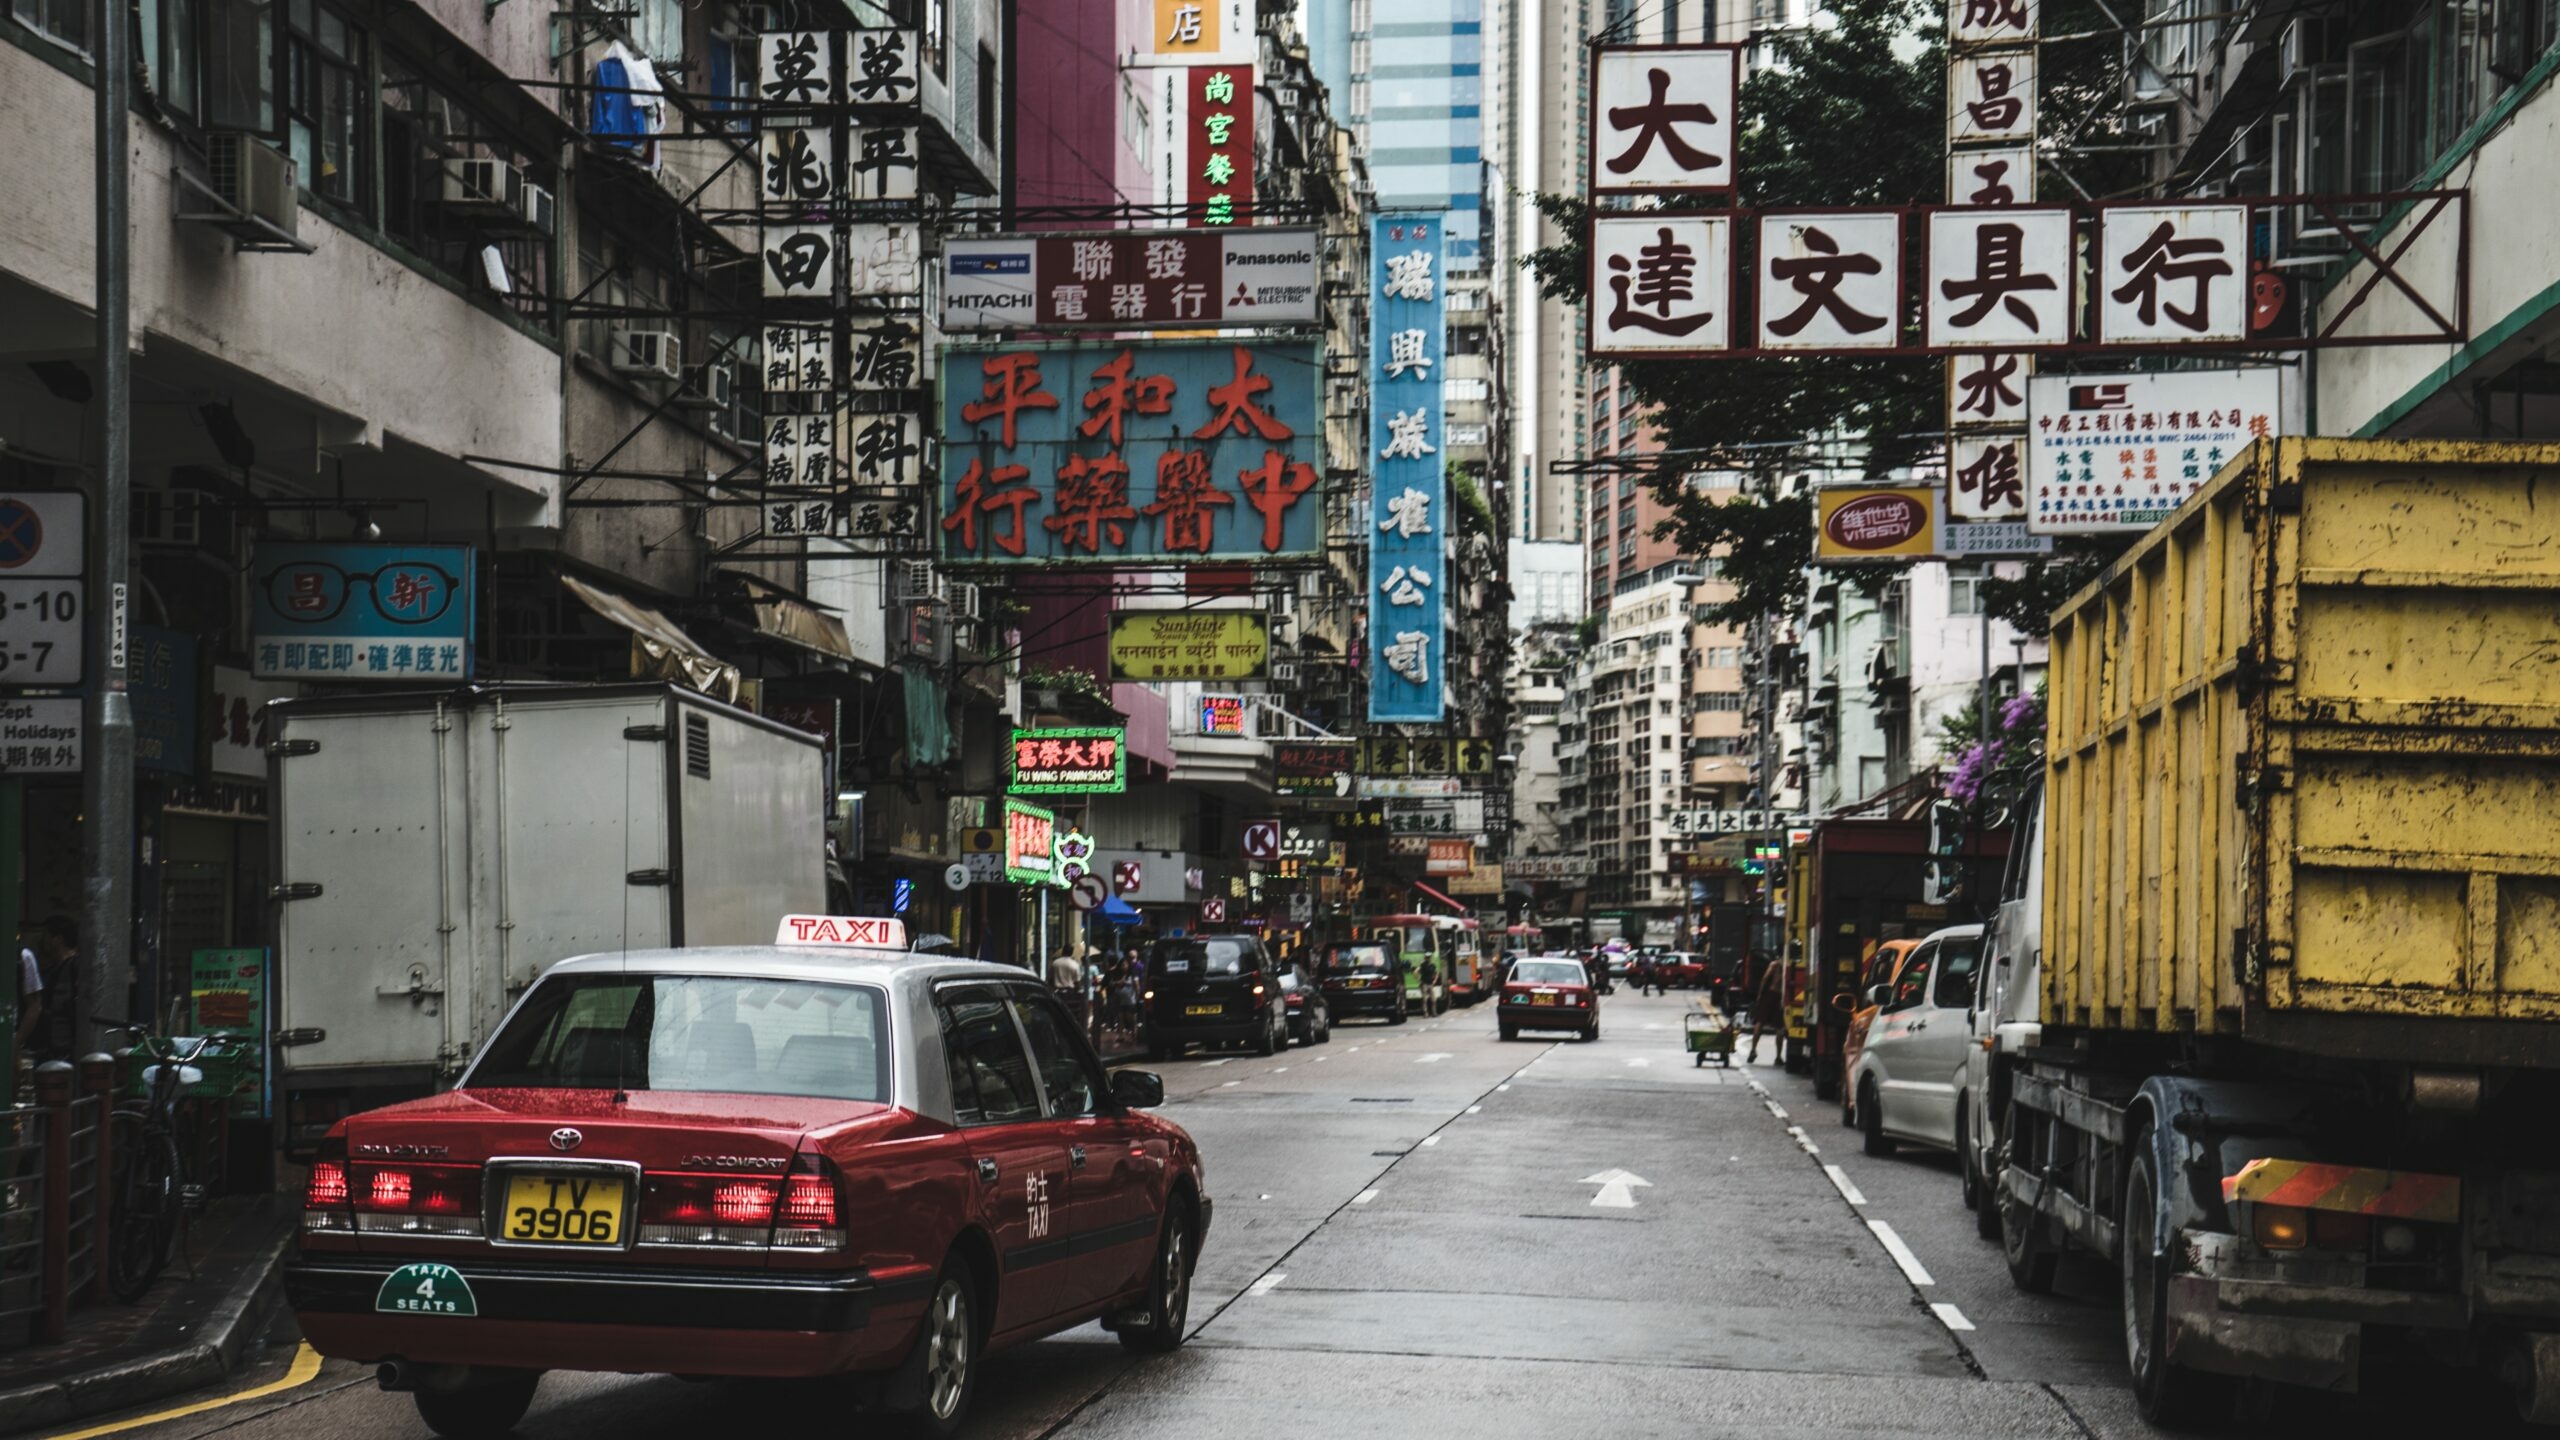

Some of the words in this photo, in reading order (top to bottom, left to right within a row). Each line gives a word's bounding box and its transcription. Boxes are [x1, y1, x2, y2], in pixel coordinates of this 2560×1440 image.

[1166, 3, 1202, 44] 店
[1606, 68, 1723, 174] 大
[1072, 240, 1187, 281] 聯發
[1225, 251, 1312, 266] Panasonic
[1257, 285, 1312, 295] MITSUBISHI
[1607, 220, 2234, 337] 達文具行
[947, 294, 1033, 309] HITACHI
[1051, 283, 1207, 320] 電器行
[1257, 295, 1305, 305] ELECTRIC
[961, 343, 1295, 451] 太和平
[1378, 249, 1436, 684] 瑞興麻雀公司
[941, 448, 1320, 557] 中醫藥行
[1841, 501, 1911, 530] 維他奶
[1843, 521, 1912, 542] vitasoy
[1968, 526, 2002, 537] 2332
[1968, 538, 2003, 550] 2780
[2006, 537, 2041, 549] 2690
[1151, 615, 1226, 633] Sunshine
[4, 725, 76, 742] Holidays
[1016, 739, 1117, 769] 富榮大押
[1017, 770, 1030, 783] FU
[1032, 770, 1058, 782] WING
[1060, 769, 1115, 782] PAWNSHOP
[953, 869, 963, 885] 3
[790, 918, 890, 944] TAXI
[715, 1156, 787, 1169] COMFORT
[544, 1178, 591, 1207] TV
[1026, 1169, 1049, 1204] 的士
[512, 1207, 613, 1241] 3906
[1026, 1203, 1049, 1240] TAXI
[408, 1264, 449, 1279] TAXI
[416, 1278, 435, 1299] 4
[397, 1298, 456, 1312] SEATS
